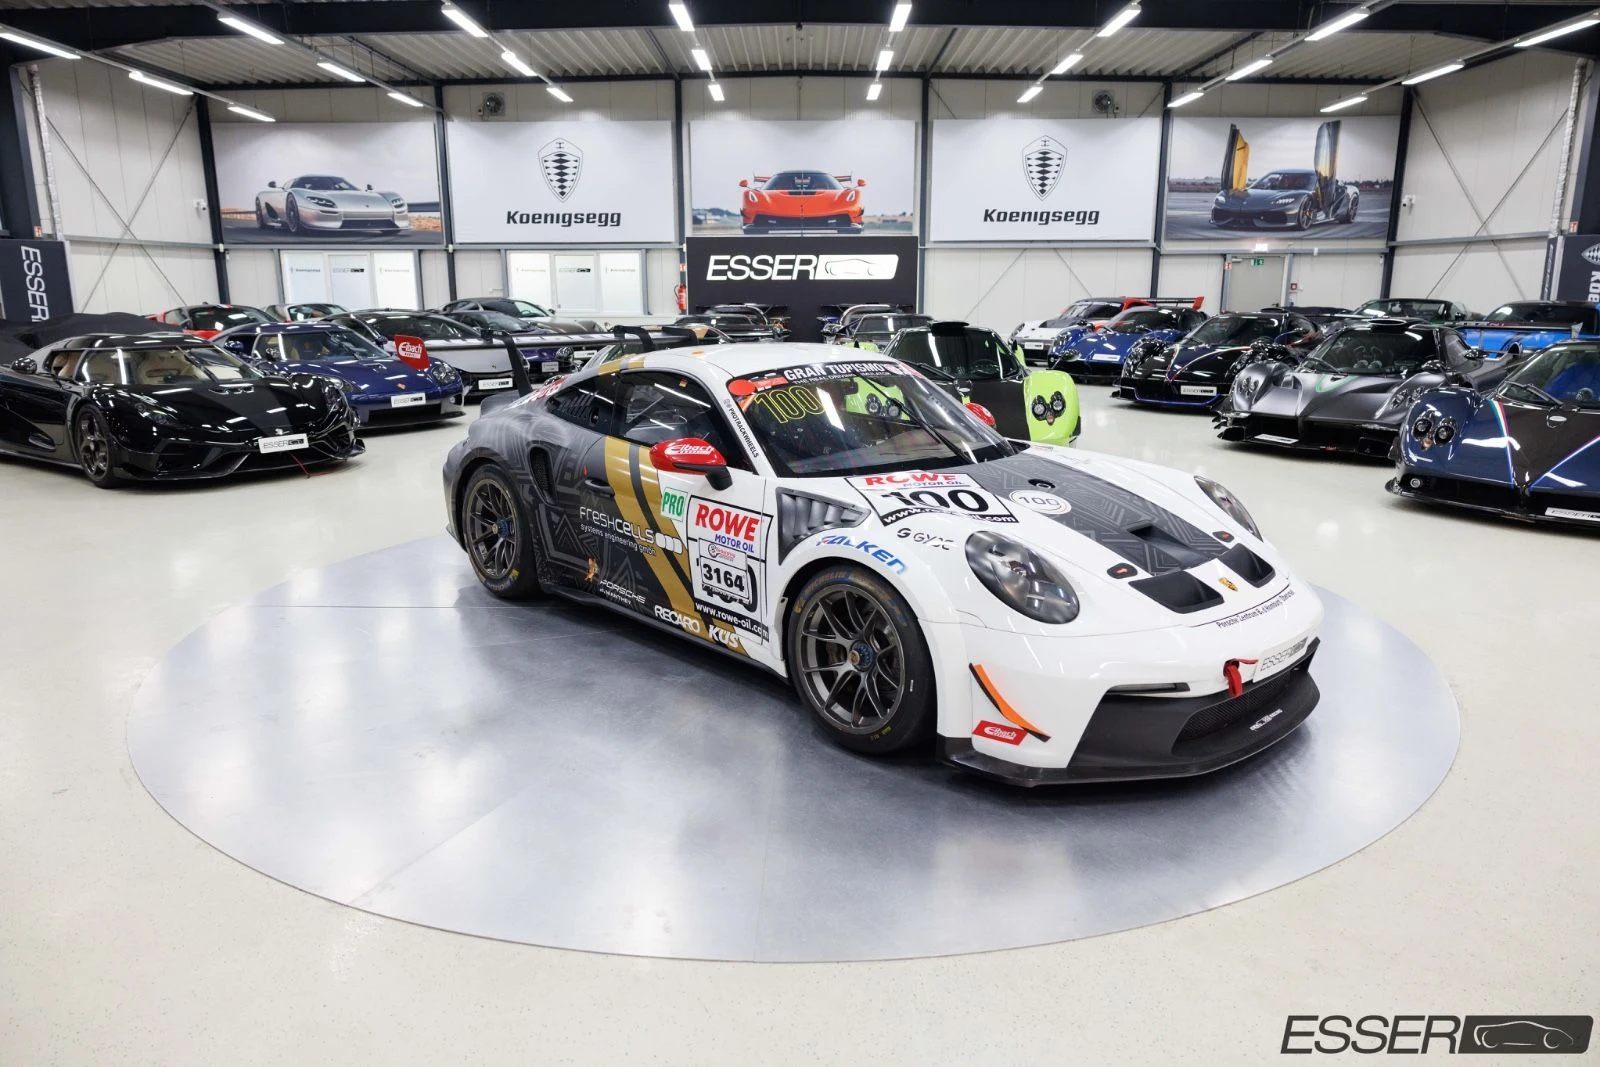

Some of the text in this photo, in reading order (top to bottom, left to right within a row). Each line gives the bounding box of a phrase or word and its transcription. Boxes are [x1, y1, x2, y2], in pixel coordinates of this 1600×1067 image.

[506, 211, 621, 227] Koenigsegg
[983, 208, 1100, 225] Koenigsegg
[706, 254, 818, 280] ESSER
[21, 245, 49, 322] ESSER
[783, 363, 826, 380] GRAN
[827, 362, 883, 374] TURISMO
[755, 386, 825, 423] 100
[728, 407, 760, 458] PROTRACKWHEELS
[664, 442, 715, 455] Eibach
[864, 473, 957, 486] ROWE
[662, 492, 684, 517] PRO
[881, 489, 989, 513] 100
[1019, 496, 1060, 506] 100
[695, 504, 760, 542] ROWE
[715, 534, 755, 554] MOTOR OIL
[702, 563, 745, 593] 3164
[599, 579, 646, 604] PORSCHE
[654, 604, 700, 633] RECARO
[695, 602, 770, 642] www.rowe-oil.com
